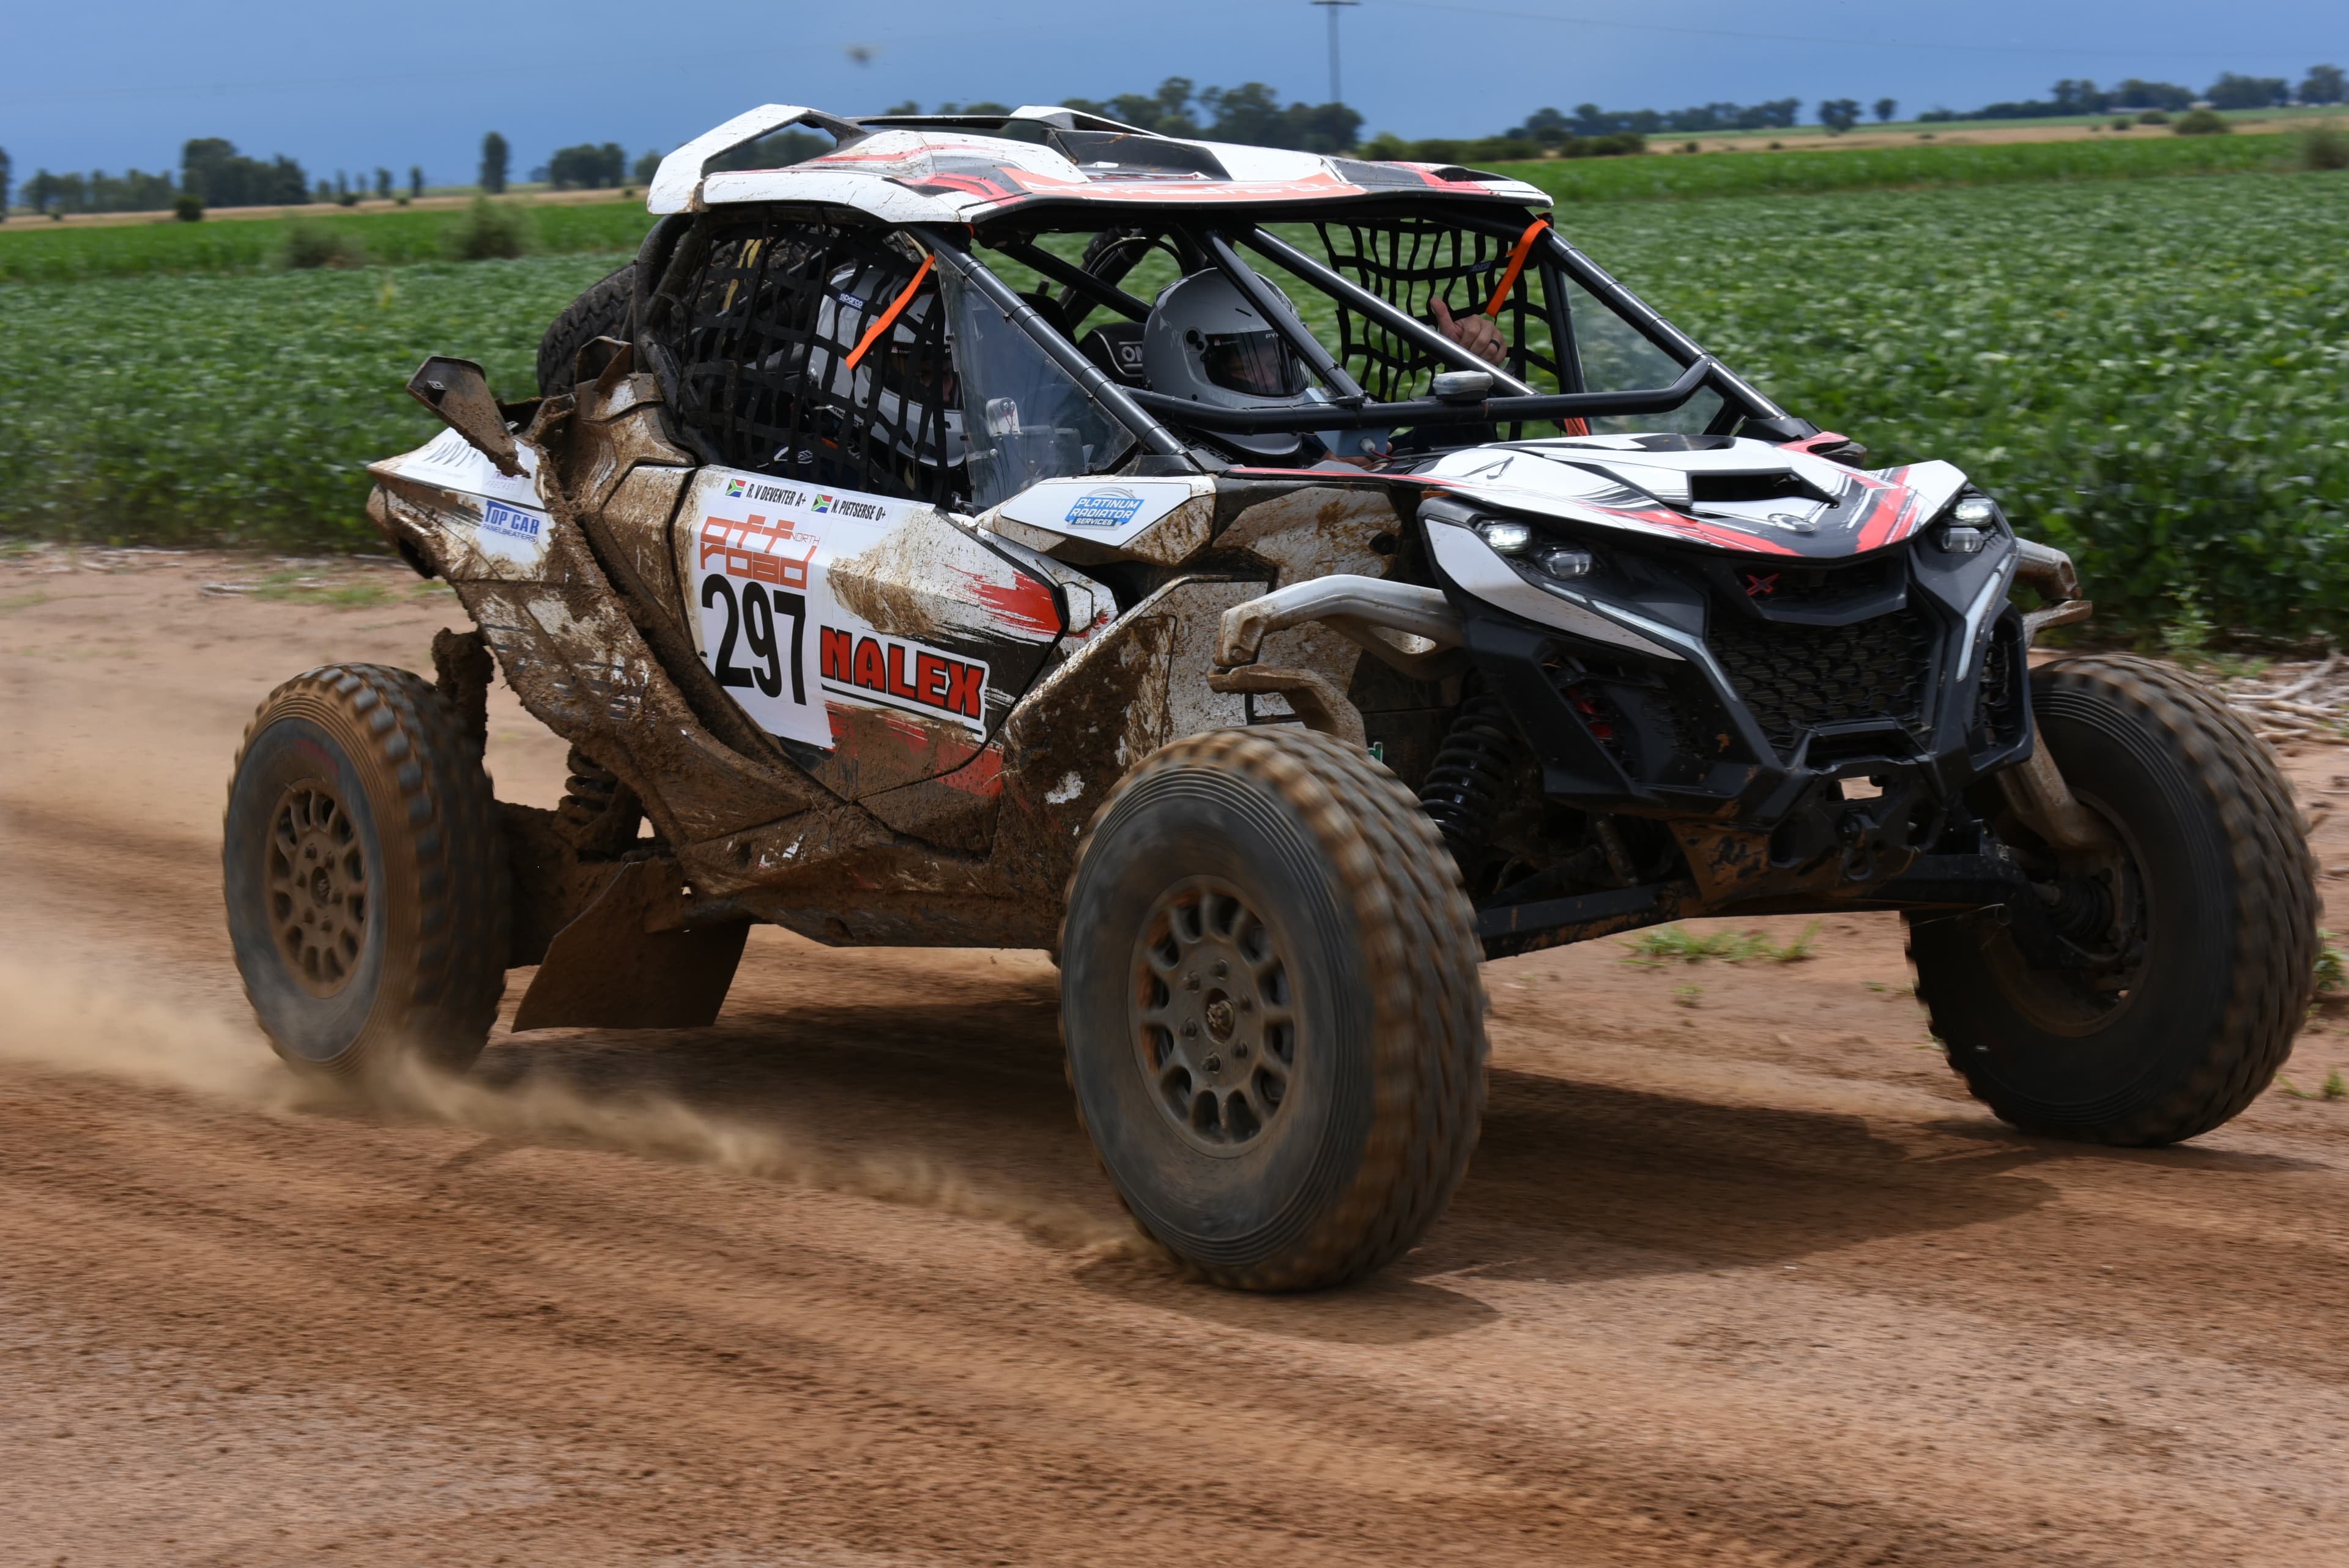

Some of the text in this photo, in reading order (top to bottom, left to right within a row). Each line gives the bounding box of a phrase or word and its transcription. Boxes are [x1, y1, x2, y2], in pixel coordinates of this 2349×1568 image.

[746, 483, 806, 507] R. V DEVENTER A+
[1076, 498, 1141, 509] PLATINUM
[484, 500, 540, 535] TOP CAR
[831, 499, 839, 513] N.
[840, 500, 876, 520] PIETSERSE
[1069, 508, 1134, 519] RADIATOR
[481, 523, 537, 543] PANELBEATERS
[792, 532, 821, 546] NORTH
[701, 573, 806, 706] 297
[819, 625, 986, 721] NALEX
